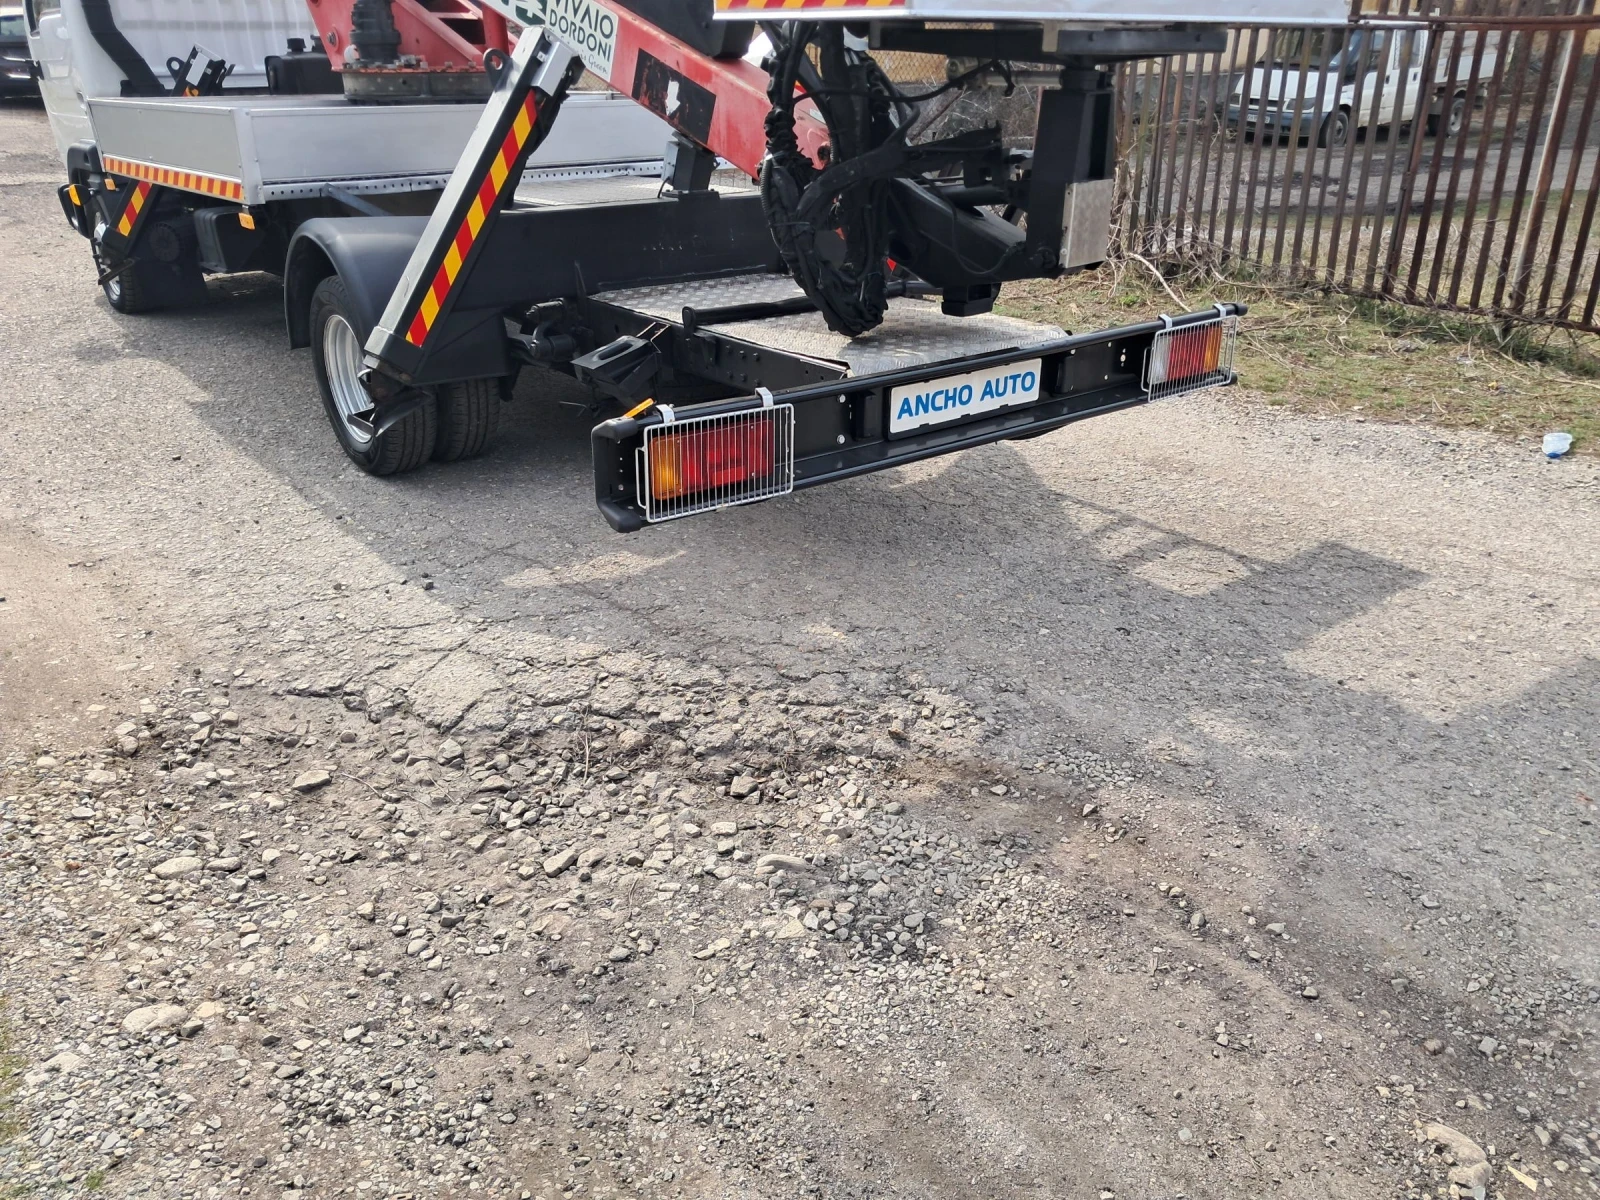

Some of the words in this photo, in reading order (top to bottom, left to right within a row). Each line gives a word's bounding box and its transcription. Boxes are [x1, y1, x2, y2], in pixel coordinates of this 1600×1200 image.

[549, 8, 612, 62] DORDONI
[896, 384, 973, 420] ANCHO
[980, 371, 1036, 401] AUTO
